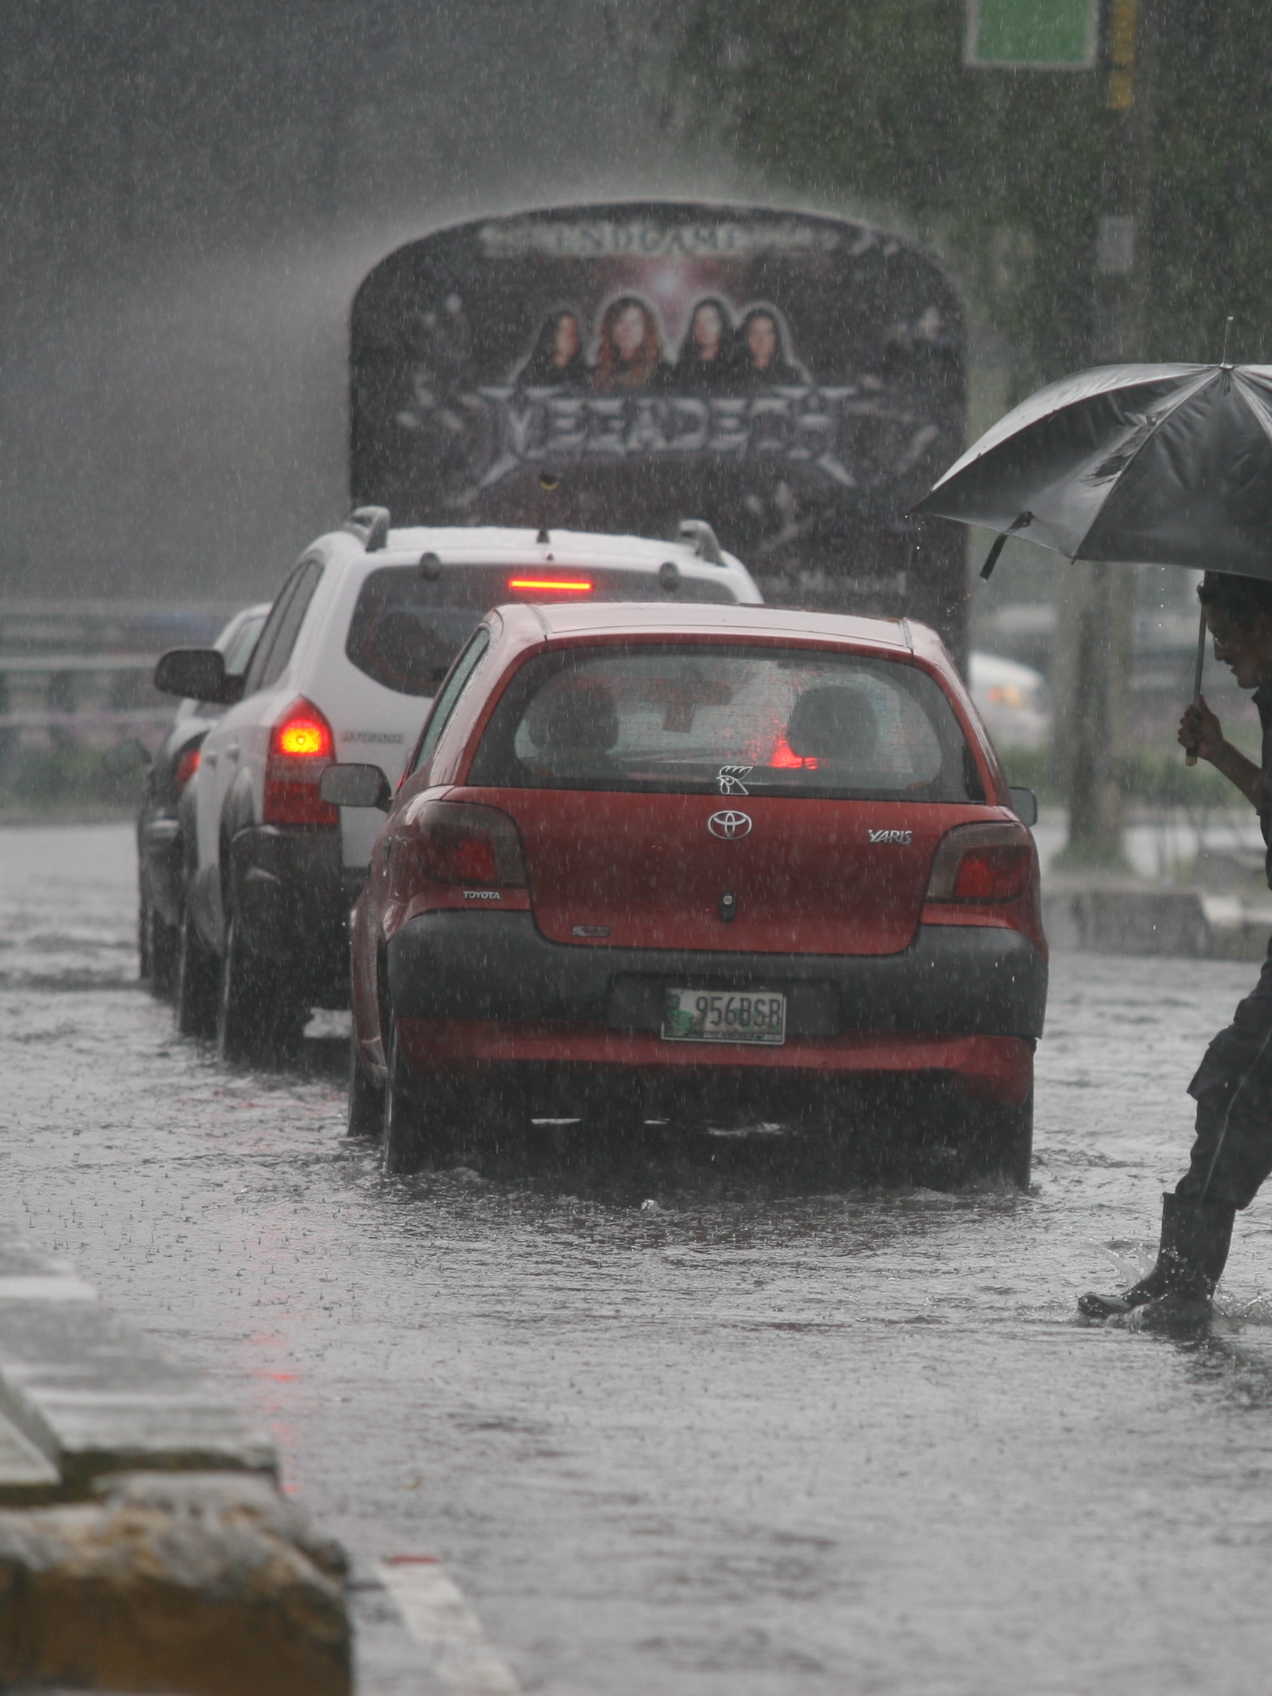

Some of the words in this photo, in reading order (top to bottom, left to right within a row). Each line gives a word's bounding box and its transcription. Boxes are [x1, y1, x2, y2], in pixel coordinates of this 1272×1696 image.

[553, 225, 739, 256] ENDGAME
[868, 829, 913, 845] YARIS
[463, 890, 500, 900] TOYOTA
